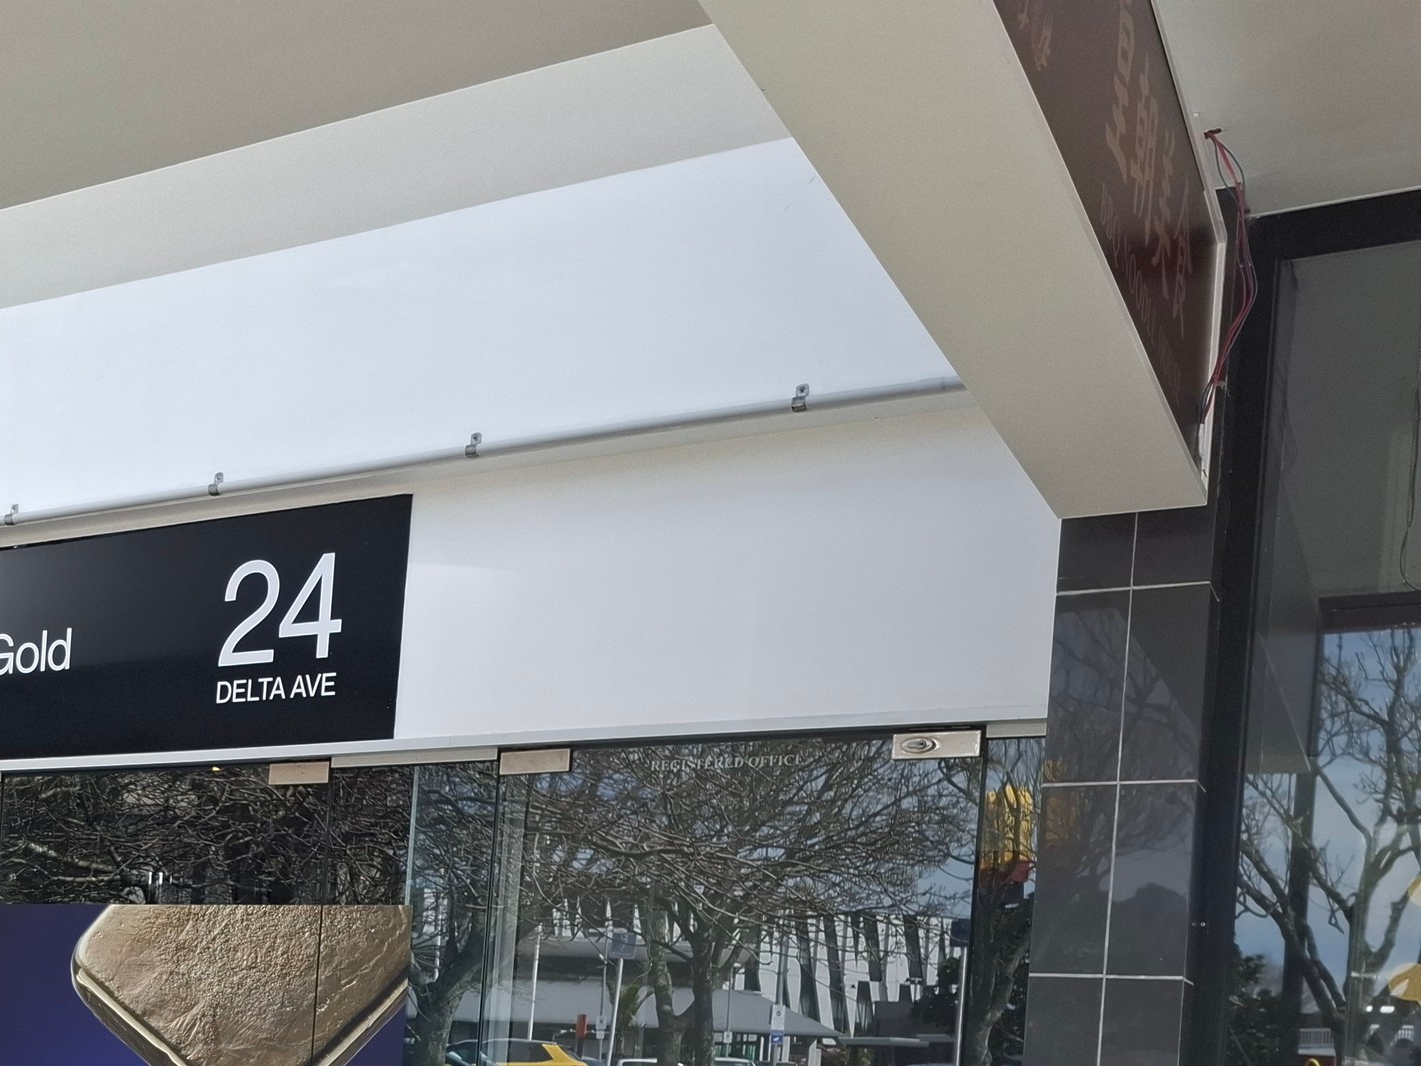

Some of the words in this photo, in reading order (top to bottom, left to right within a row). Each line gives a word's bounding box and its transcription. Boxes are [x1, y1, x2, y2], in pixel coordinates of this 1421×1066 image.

[218, 553, 342, 667] 24
[216, 677, 285, 703] DELTA
[290, 672, 336, 698] AVE
[651, 754, 744, 771] REGISTERED
[748, 754, 805, 769] OFFICE
